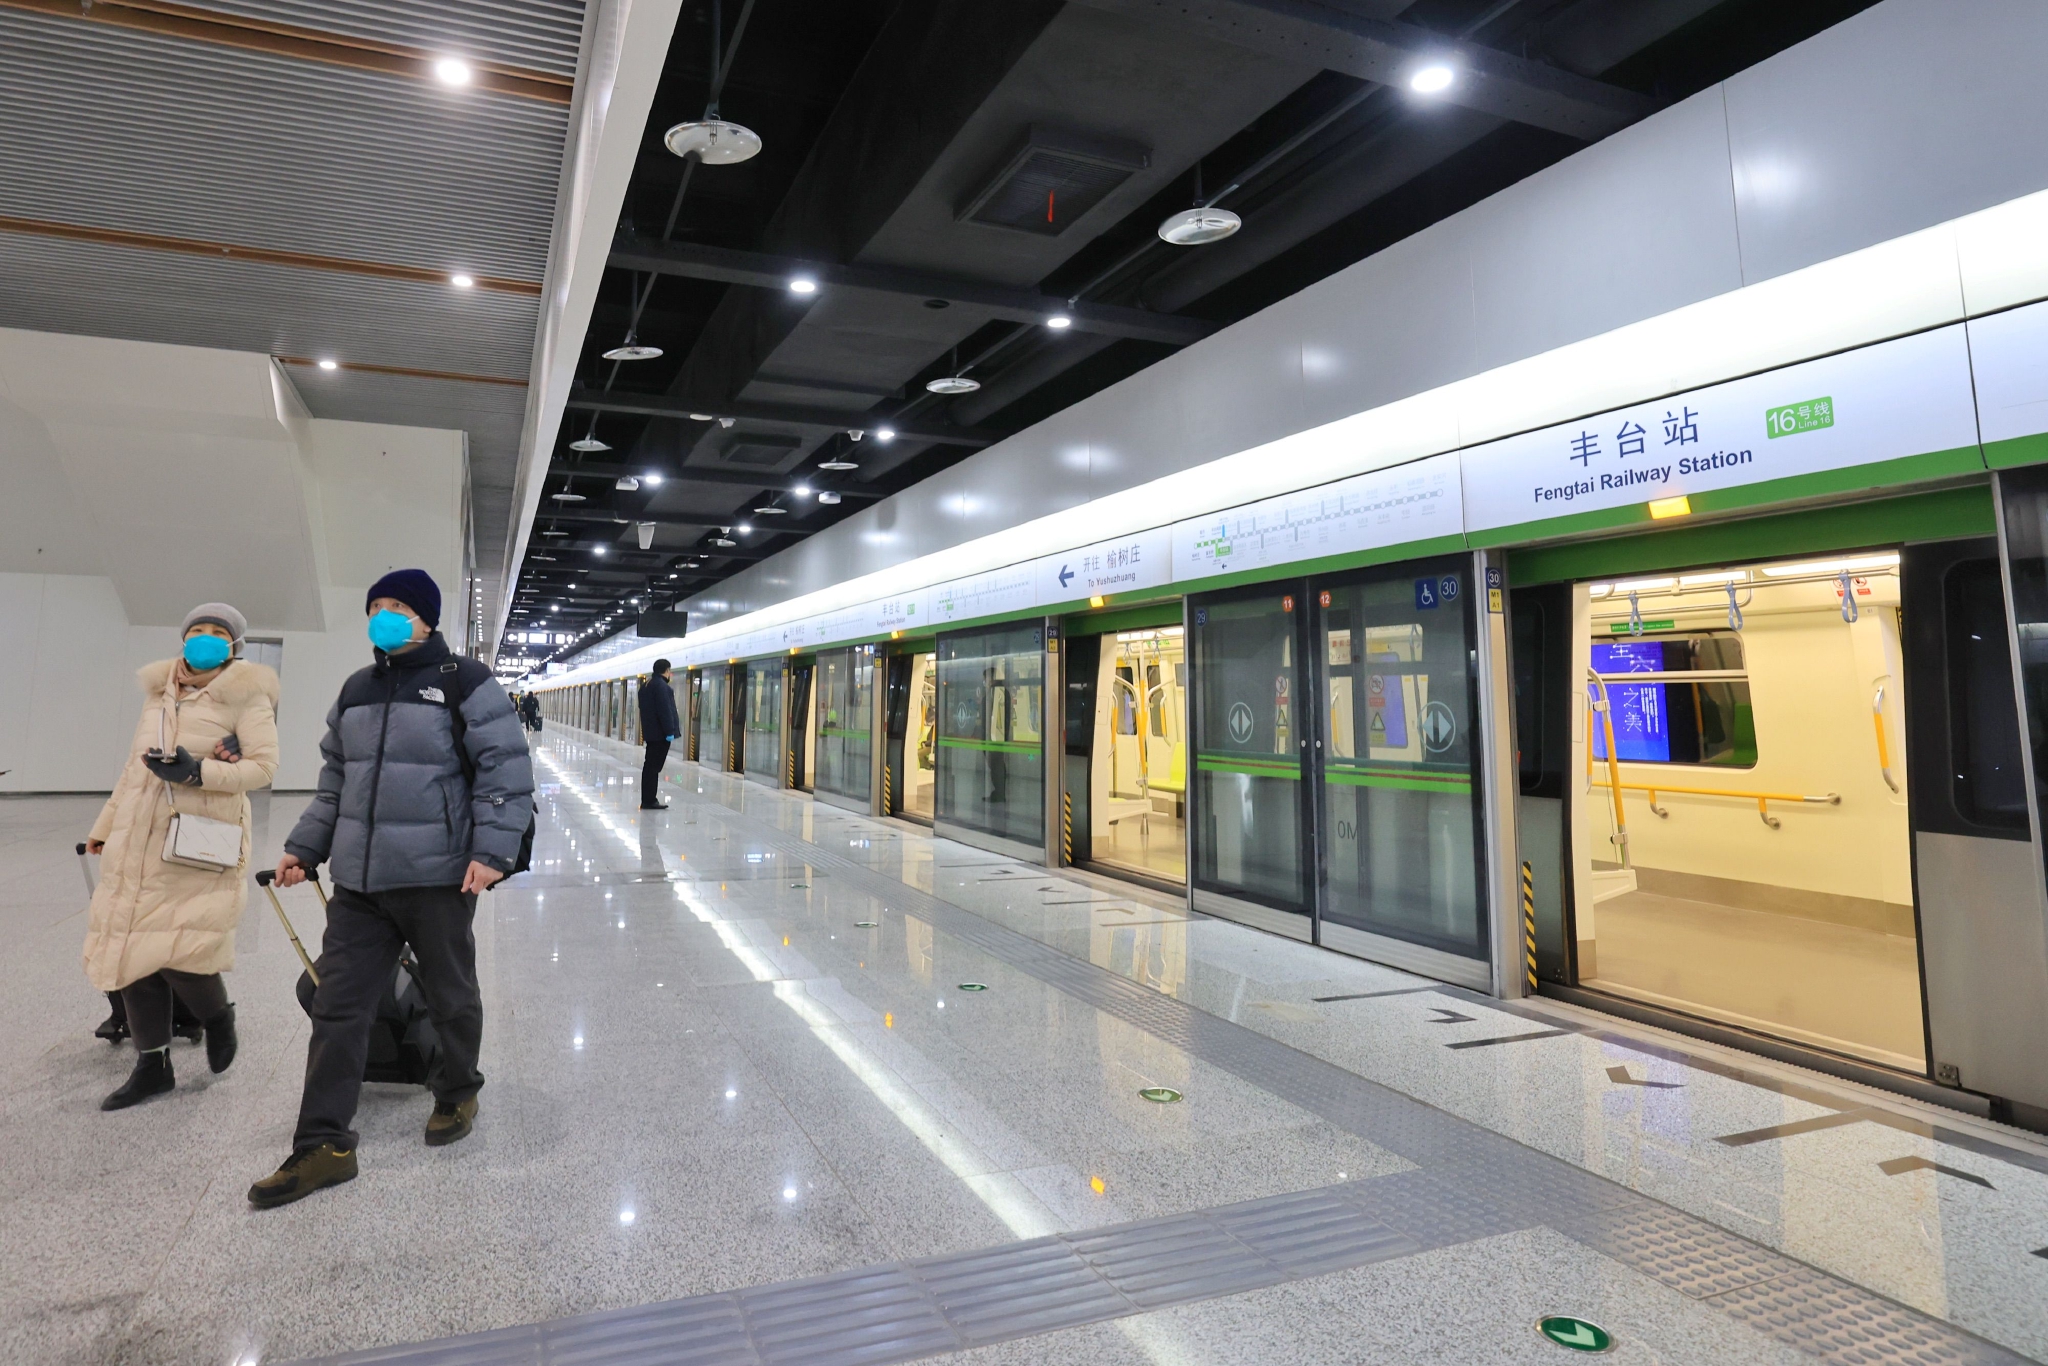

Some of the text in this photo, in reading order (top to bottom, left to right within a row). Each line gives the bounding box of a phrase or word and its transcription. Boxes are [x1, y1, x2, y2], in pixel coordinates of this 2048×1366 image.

[1768, 401, 1830, 434] 16 号线
[1798, 415, 1831, 429] Line 16
[1569, 406, 1699, 467] 丰台站
[1534, 449, 1753, 503] Fengtai Railway Station
[1083, 543, 1141, 573] 开往 榆树庄
[1088, 572, 1136, 588] To Yushuzhuang
[1489, 573, 1500, 583] 30
[1442, 581, 1457, 596] 30
[1284, 599, 1292, 609] 11
[1321, 594, 1330, 604] 12
[1197, 612, 1206, 624] 29
